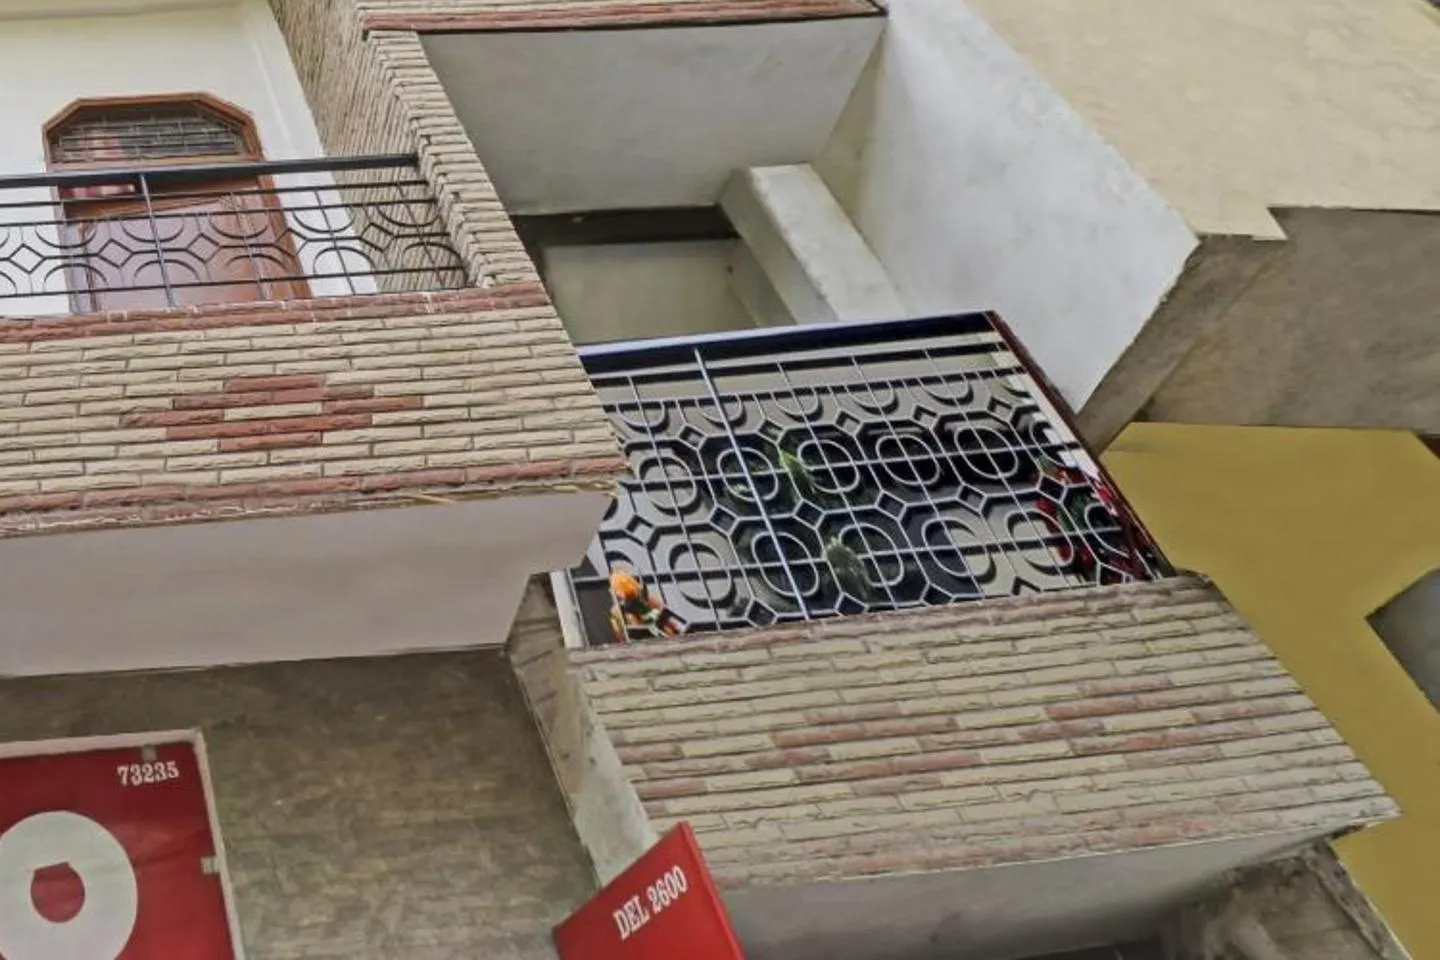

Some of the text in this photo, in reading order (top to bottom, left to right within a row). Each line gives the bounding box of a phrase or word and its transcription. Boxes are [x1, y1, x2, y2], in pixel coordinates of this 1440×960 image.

[117, 760, 180, 786] 73235
[612, 865, 688, 940] DEL 2600
